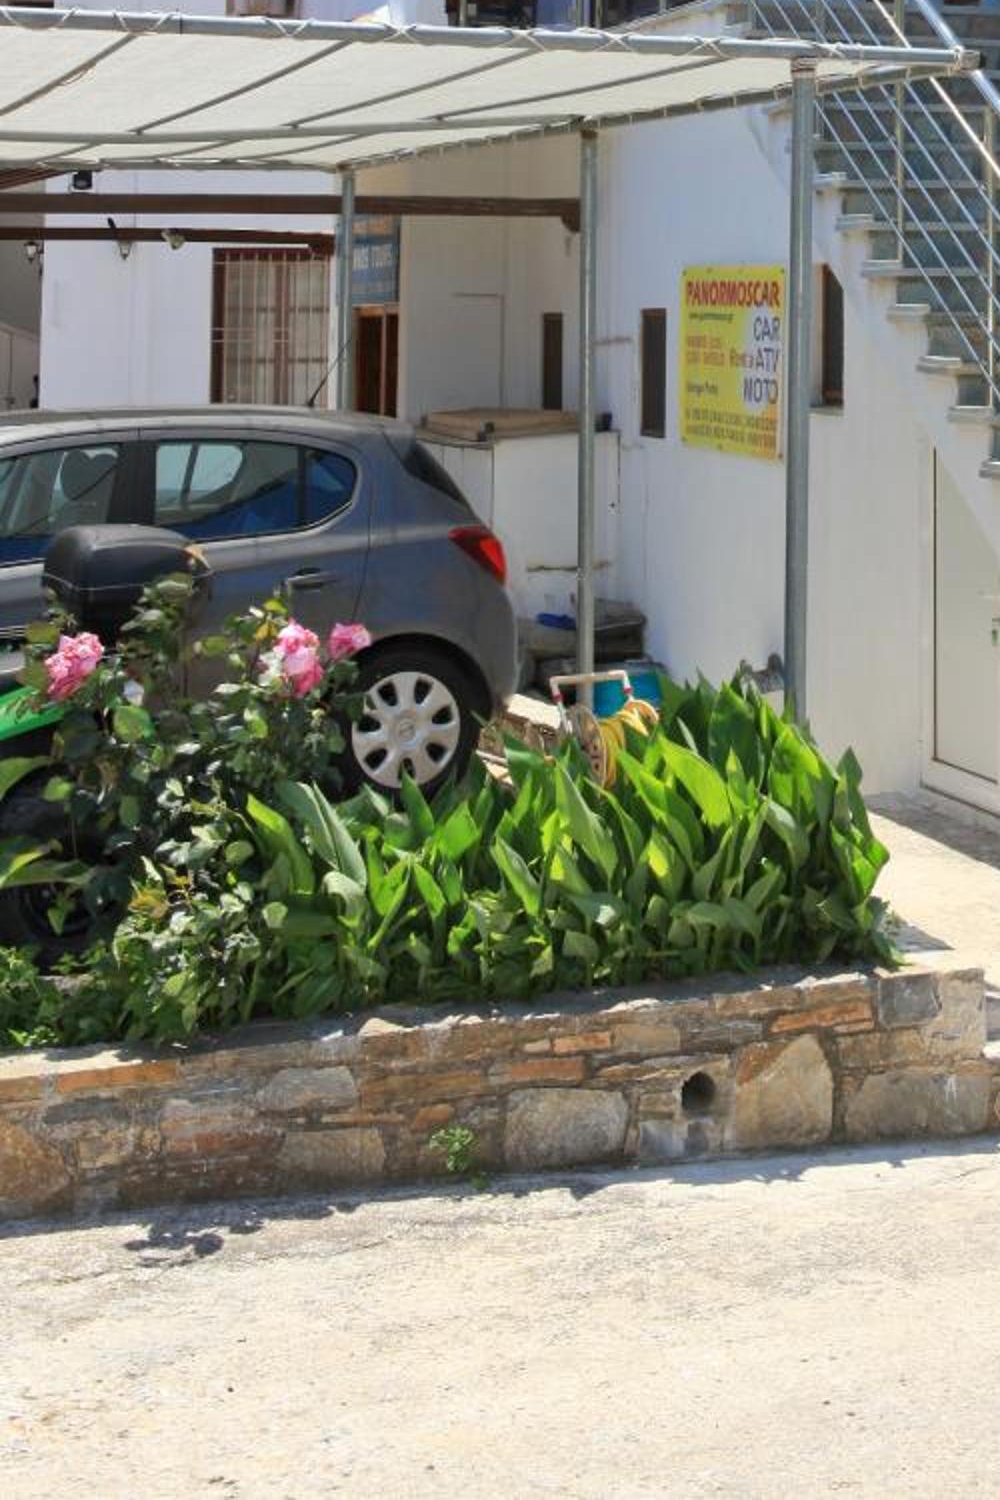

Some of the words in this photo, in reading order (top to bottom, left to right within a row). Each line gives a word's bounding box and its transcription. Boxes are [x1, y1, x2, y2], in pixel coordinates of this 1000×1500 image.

[687, 280, 780, 307] PANORMOSCAR
[754, 316, 780, 341] CAR
[756, 347, 780, 372] ATV
[744, 377, 778, 404] MOTO
